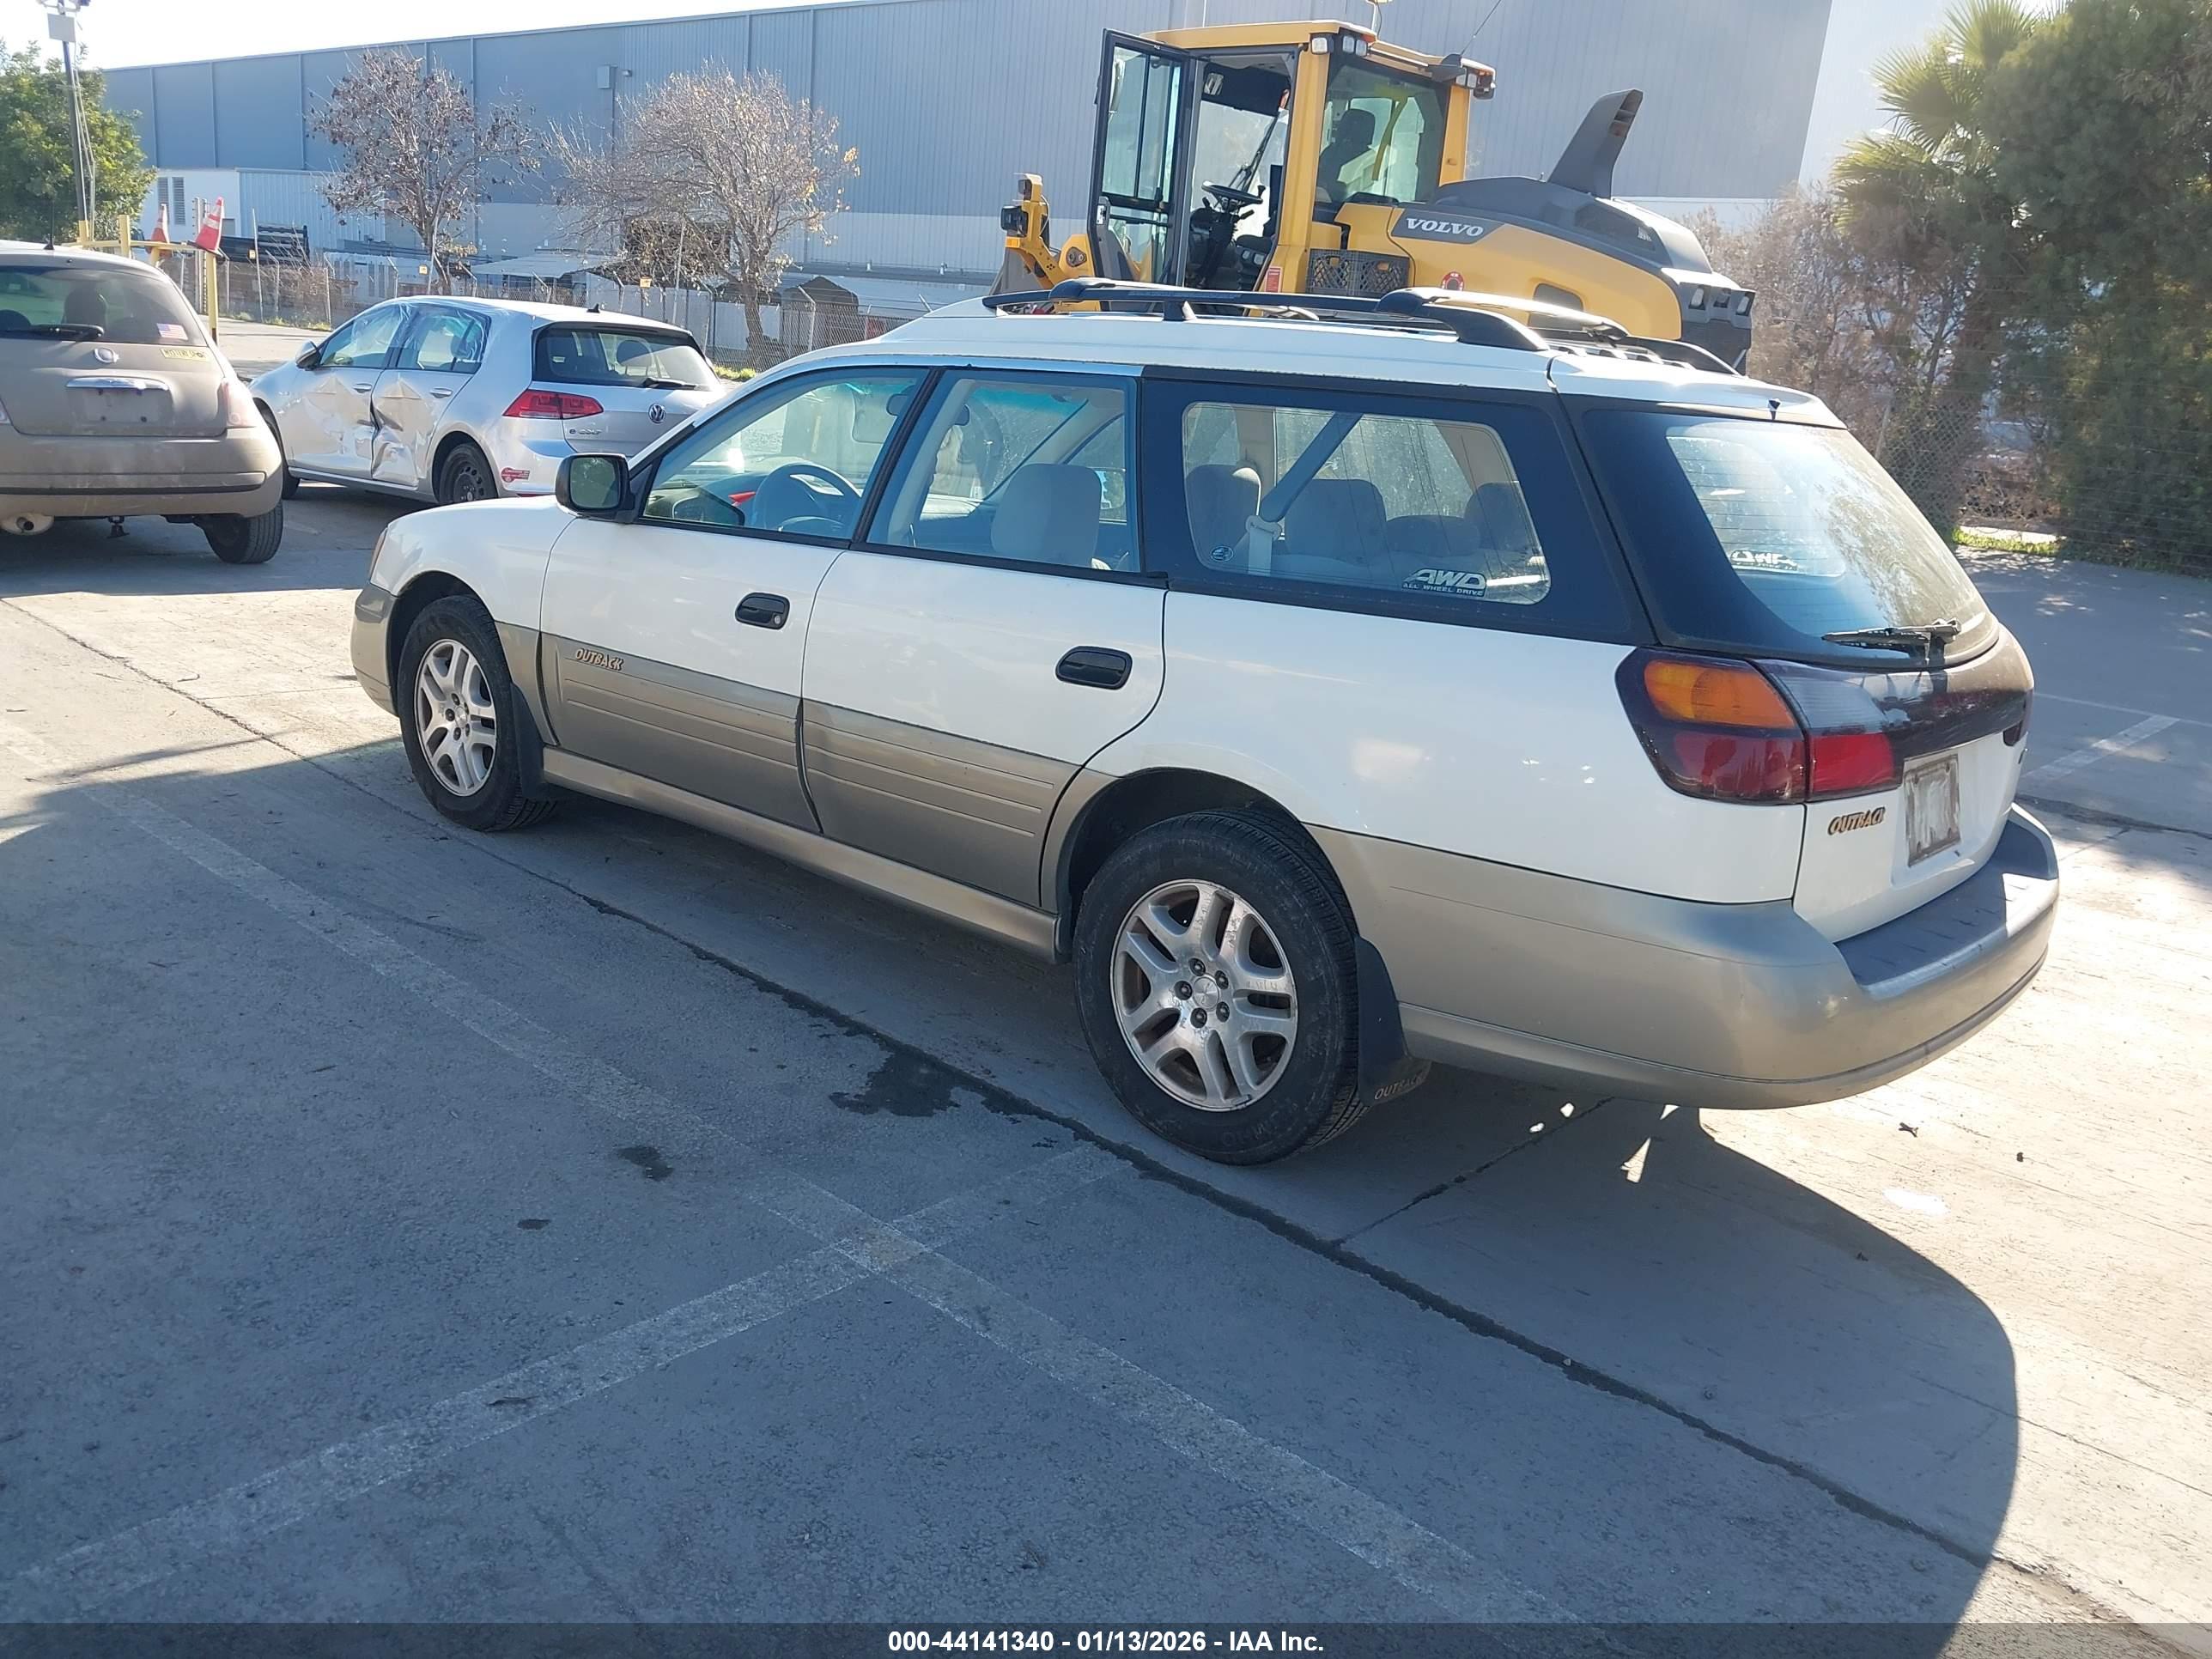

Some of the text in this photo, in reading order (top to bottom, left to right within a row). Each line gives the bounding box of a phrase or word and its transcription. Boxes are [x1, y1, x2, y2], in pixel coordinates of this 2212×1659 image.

[1407, 217, 1484, 237] VOLVO
[1403, 568, 1486, 590] AWD
[1423, 584, 1454, 593] WHEEL
[1456, 588, 1484, 597] DRIVE
[575, 647, 624, 671] OUTBACK
